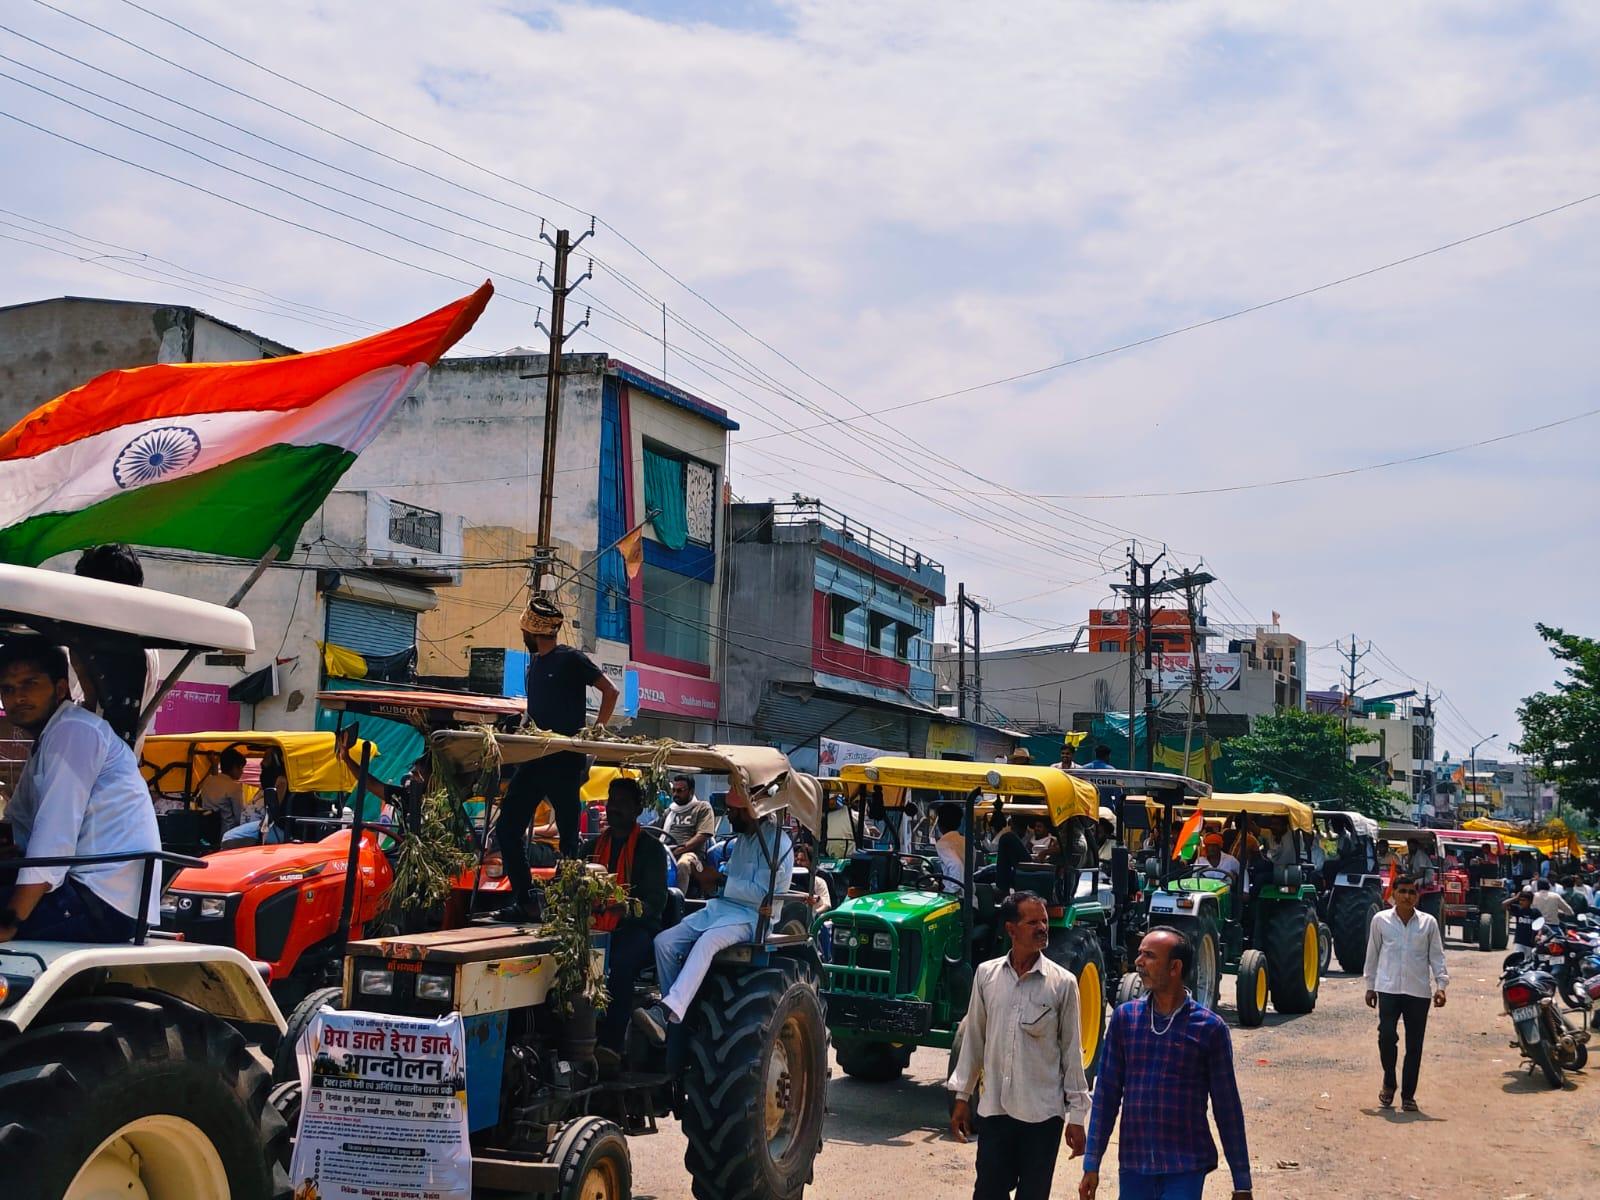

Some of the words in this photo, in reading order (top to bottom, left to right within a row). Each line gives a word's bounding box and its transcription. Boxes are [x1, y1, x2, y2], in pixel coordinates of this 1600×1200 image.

[637, 687, 666, 703] ONDA
[379, 705, 419, 716] KUBOTA
[324, 1024, 349, 1048] घेरा
[352, 1028, 386, 1051] डाले
[390, 1029, 418, 1053] डेरा
[421, 1032, 452, 1055] डाले
[342, 1053, 443, 1081] आन्दोलन
